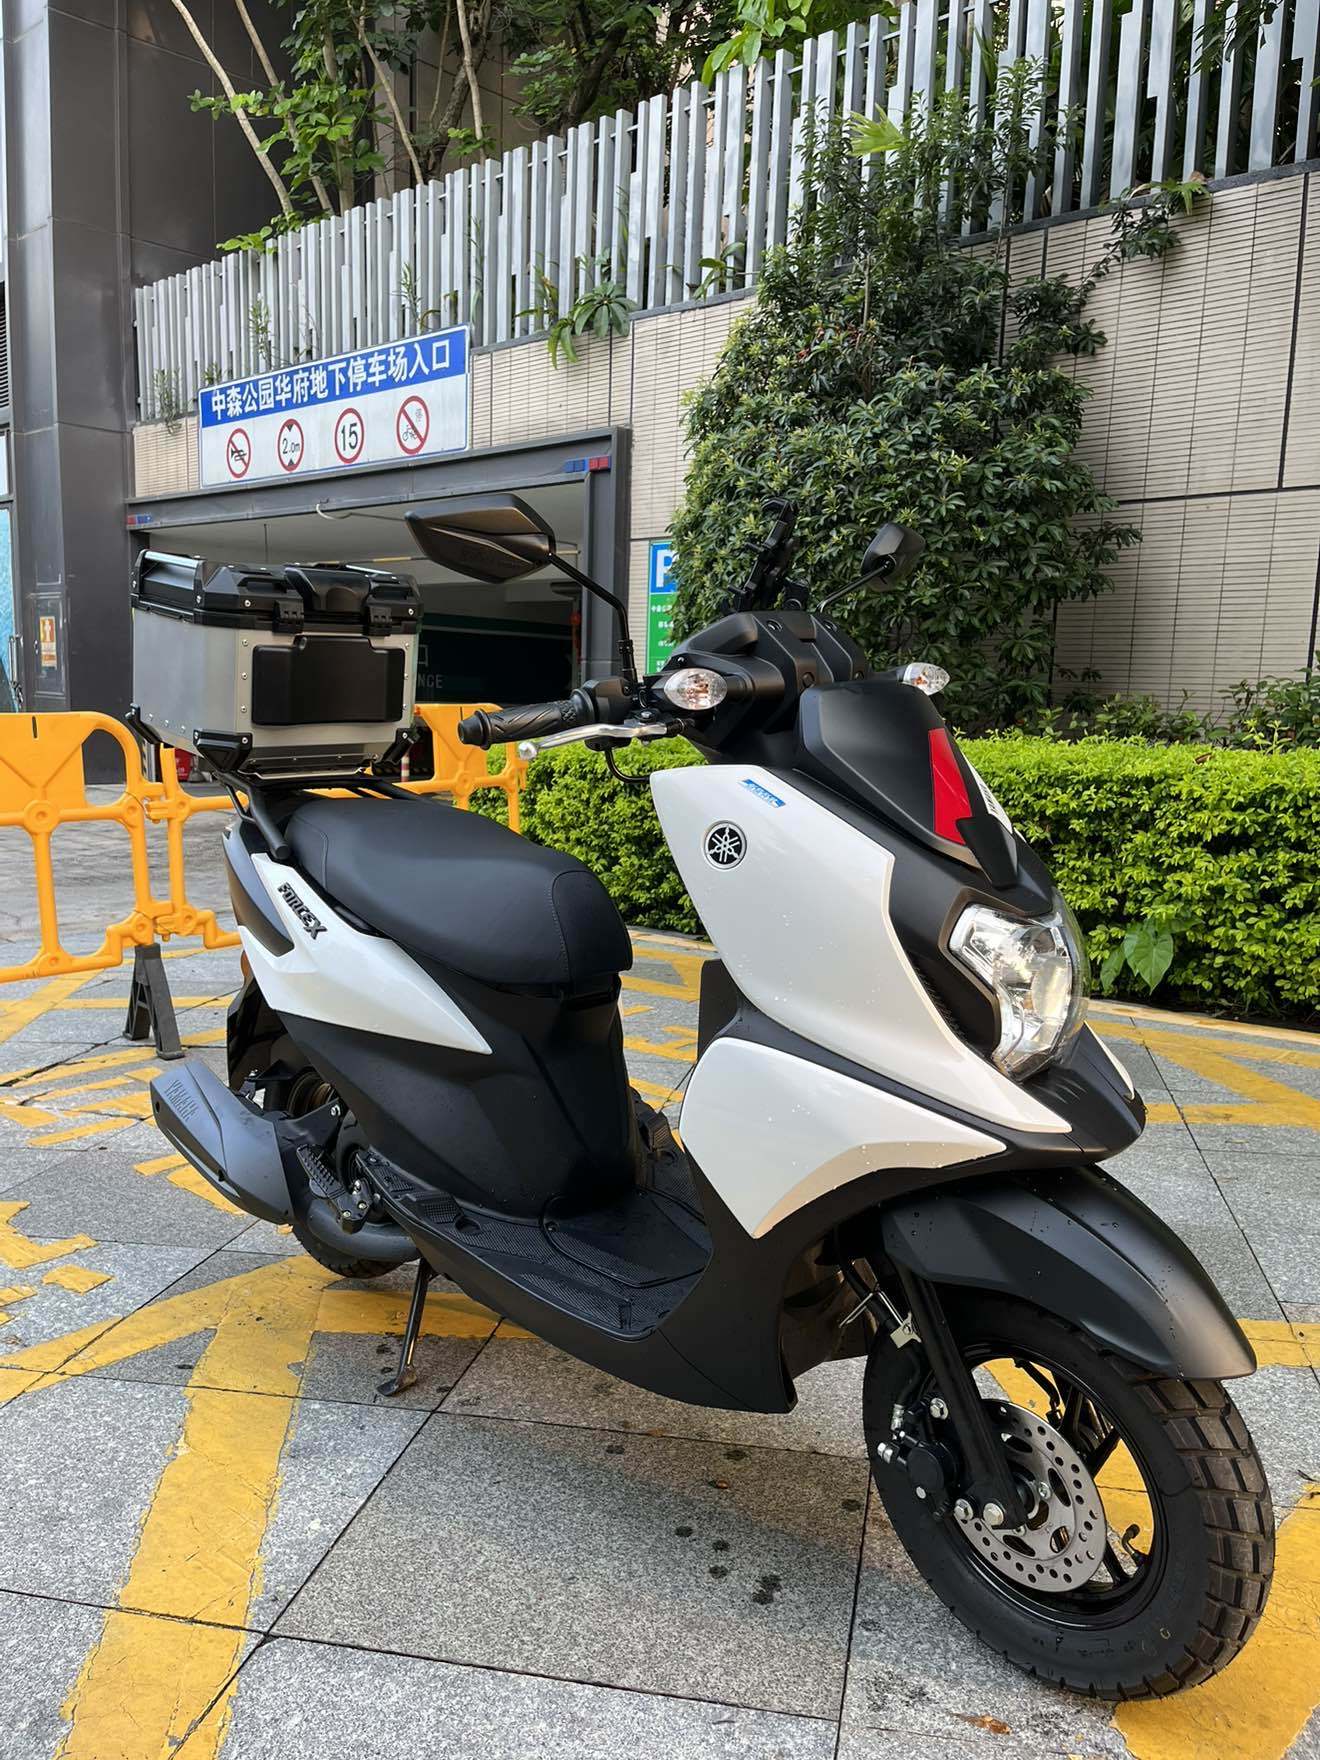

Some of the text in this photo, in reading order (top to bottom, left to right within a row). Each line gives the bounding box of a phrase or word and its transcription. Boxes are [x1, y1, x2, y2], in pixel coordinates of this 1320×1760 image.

[211, 339, 450, 420] 中森公园华府地下停车场入口
[282, 438, 300, 454] 2.0m
[341, 422, 359, 451] 15
[656, 549, 679, 588] P
